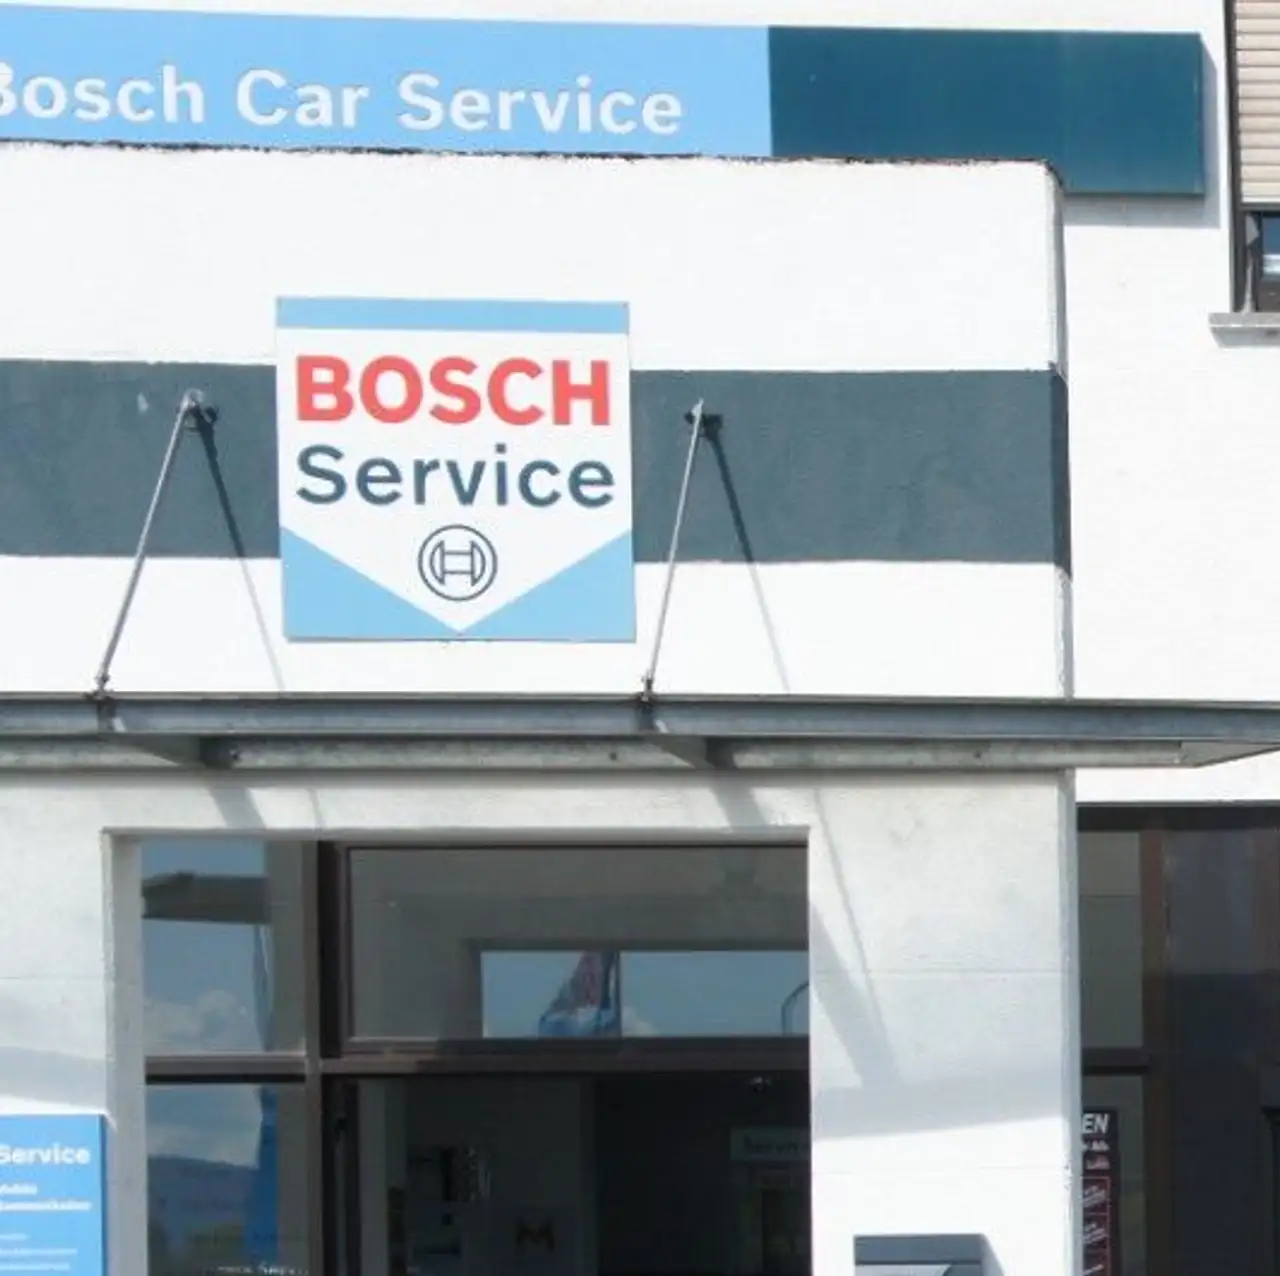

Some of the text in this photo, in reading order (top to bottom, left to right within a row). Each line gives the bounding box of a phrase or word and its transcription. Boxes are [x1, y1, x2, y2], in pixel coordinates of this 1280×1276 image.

[237, 68, 369, 128] Car
[398, 71, 682, 135] Service
[296, 355, 611, 426] BOSCH
[296, 443, 615, 508] Service
